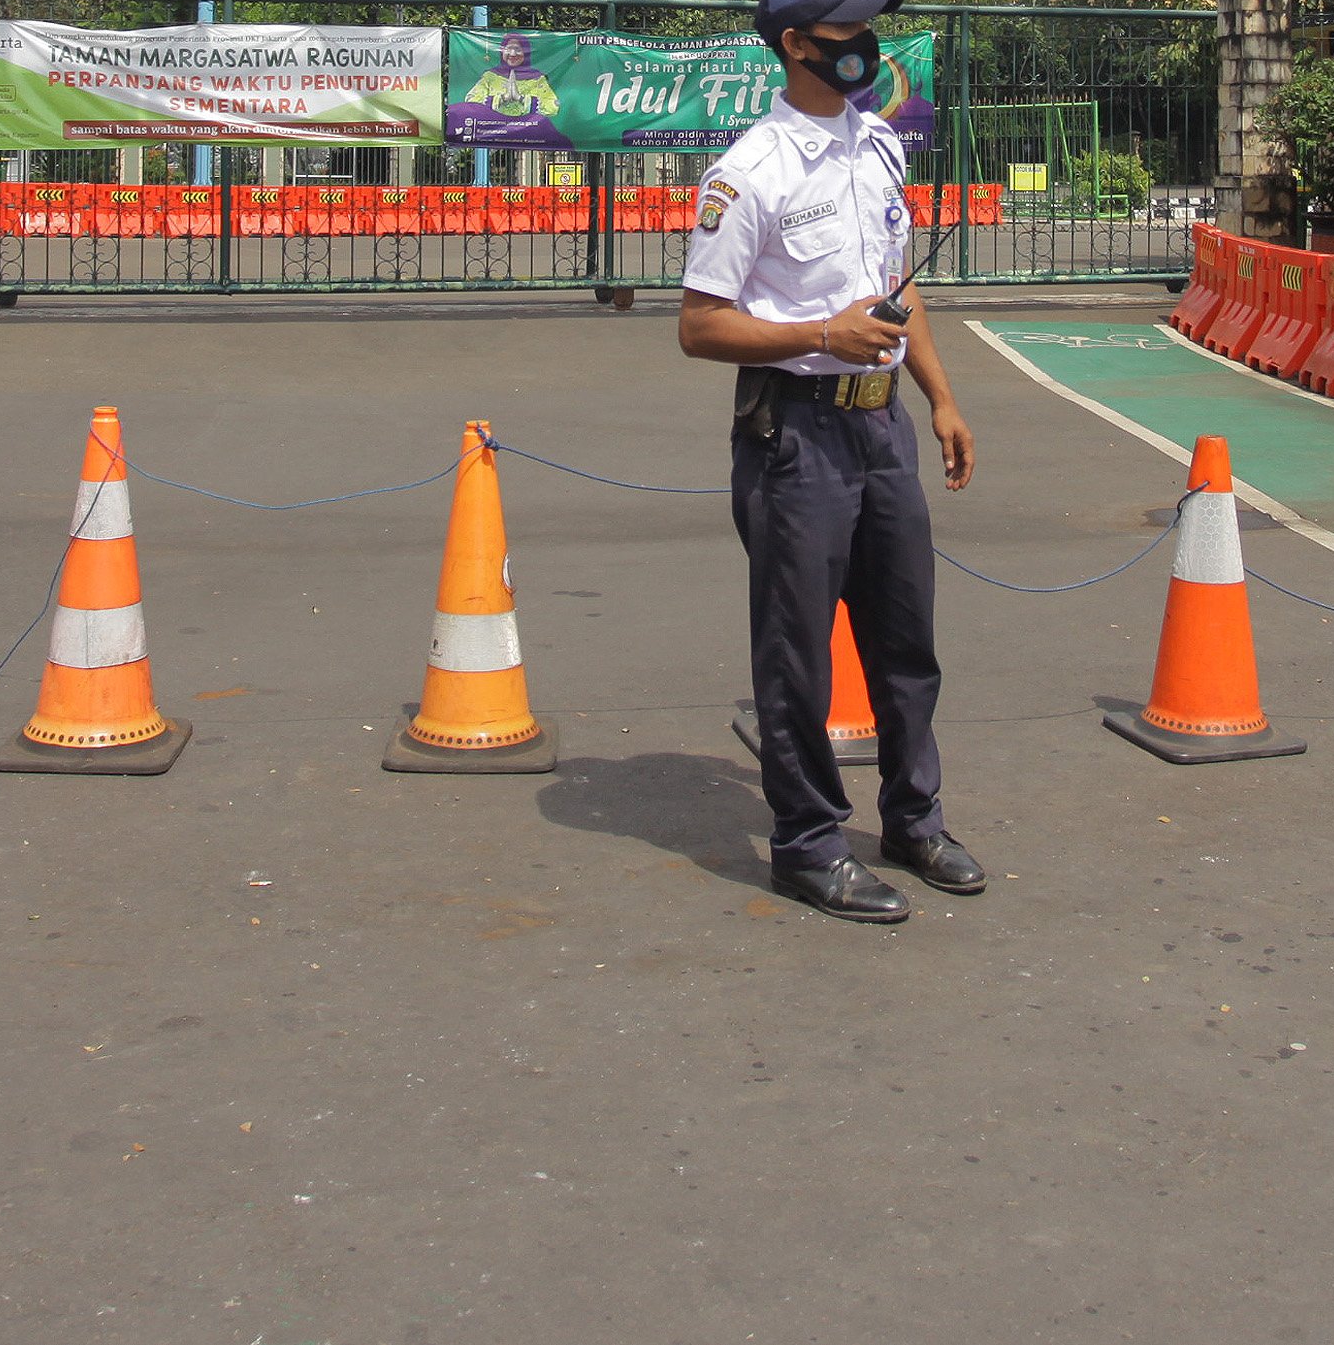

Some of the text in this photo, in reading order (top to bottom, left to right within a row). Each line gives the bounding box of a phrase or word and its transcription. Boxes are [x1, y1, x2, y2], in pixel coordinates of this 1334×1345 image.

[579, 36, 767, 50] UNIT PENGELOLA TAMAN MARGASATW
[48, 44, 414, 68] TAMAN MARGASATWA RAGUNAN
[624, 61, 782, 74] Selamat Hari Raya
[48, 71, 418, 92] PERPANJANG WAKTU PENUTUPAN
[596, 72, 686, 115] Idul
[169, 97, 308, 114] SEMENTARA
[71, 124, 112, 136] sampai
[116, 123, 147, 135] batas
[151, 124, 187, 135] waktu
[189, 125, 218, 136] yang
[220, 124, 251, 134] akan
[342, 124, 372, 135] lebih
[374, 123, 413, 136] lanjut.
[644, 130, 673, 139] Minal
[678, 130, 705, 139] aidin
[709, 130, 729, 139] wal
[896, 131, 924, 141] karta
[632, 138, 730, 146] Mohon Maaf Lahir
[784, 205, 833, 227] MUHAMAD
